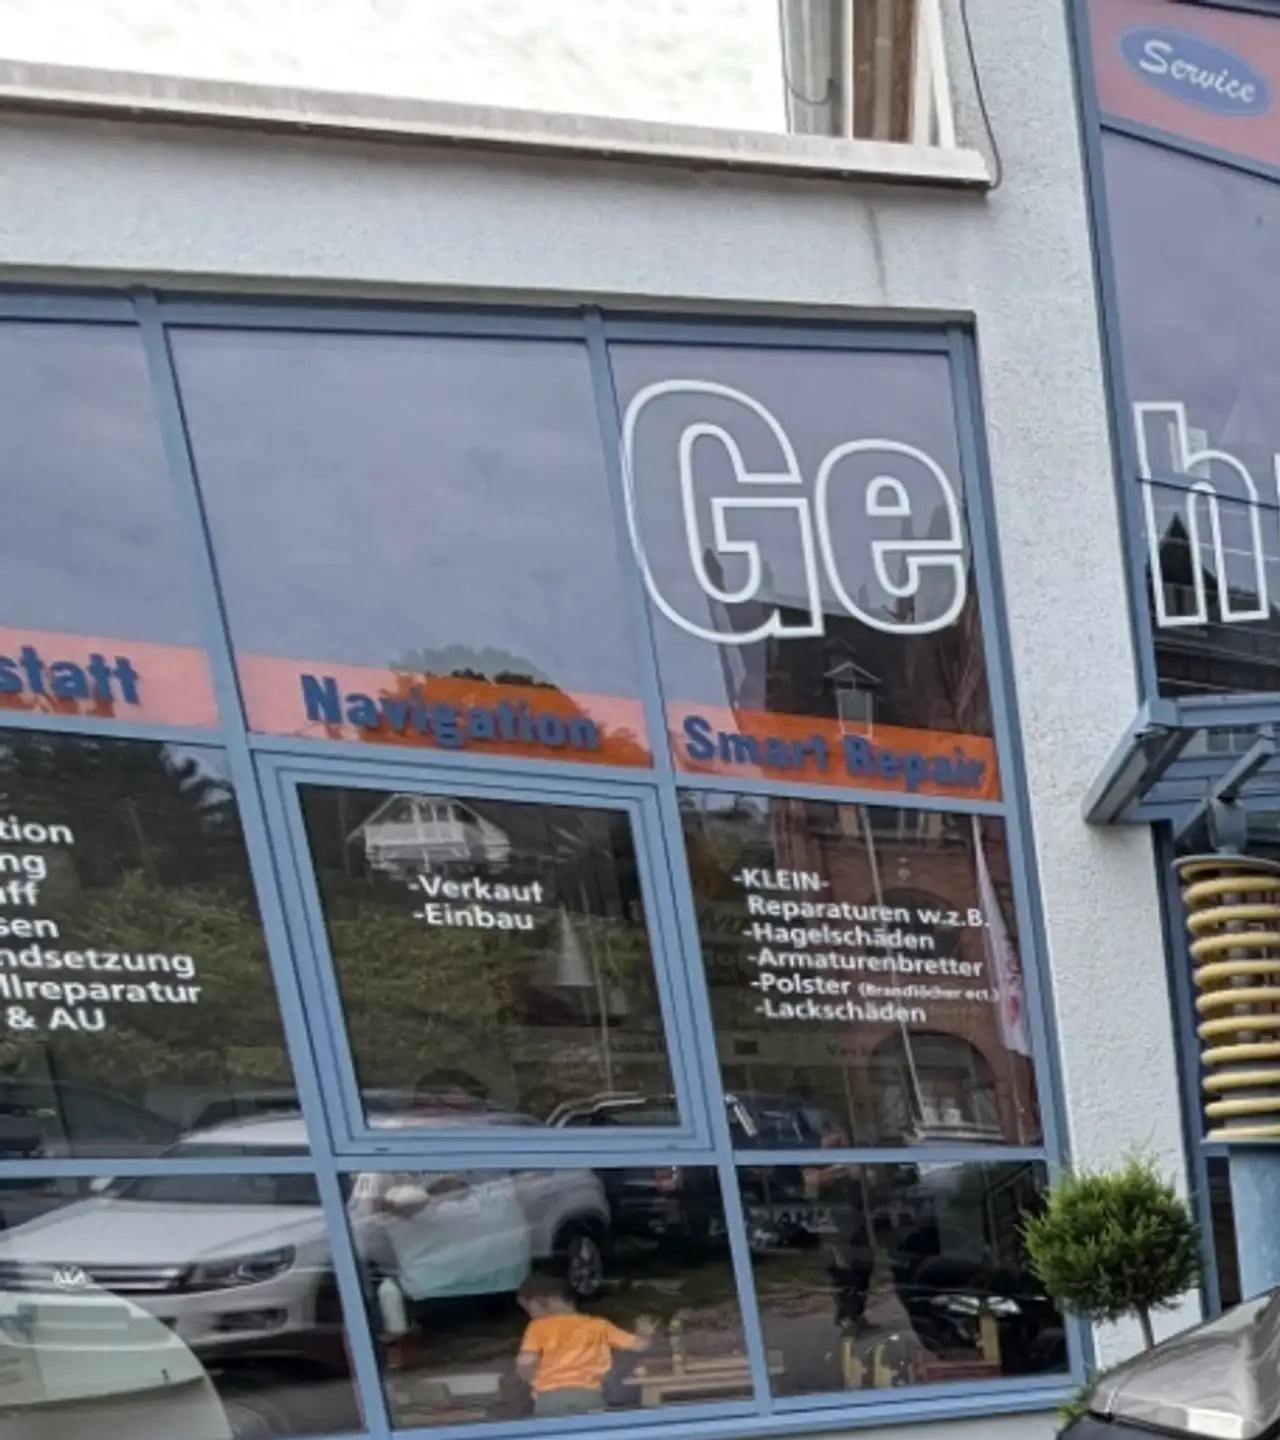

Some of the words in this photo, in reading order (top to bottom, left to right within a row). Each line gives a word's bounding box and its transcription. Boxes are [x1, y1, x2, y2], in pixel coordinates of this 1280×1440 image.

[1139, 39, 1256, 104] Service
[622, 379, 968, 645] Ge
[301, 674, 601, 751] Navigation
[683, 715, 829, 773] Smart
[842, 734, 988, 793] Repair
[413, 902, 534, 930] -Einbau
[747, 894, 911, 924] Reparaturen
[6, 1006, 36, 1030] &
[48, 1006, 106, 1032] AU
